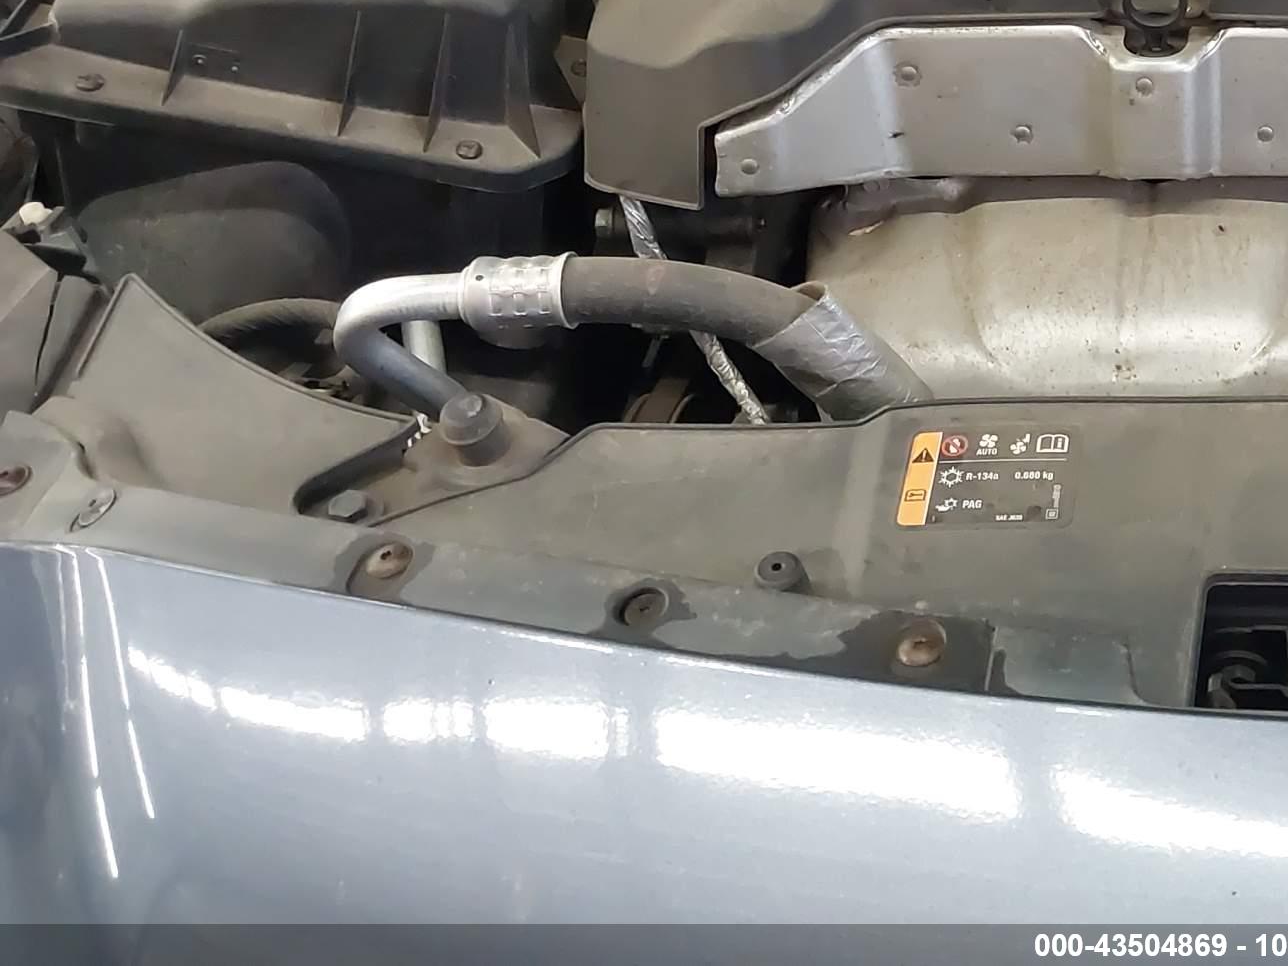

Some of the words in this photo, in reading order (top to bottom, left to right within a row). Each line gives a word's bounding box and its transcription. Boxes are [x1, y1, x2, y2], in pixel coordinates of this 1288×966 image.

[976, 448, 998, 456] AUTO
[965, 472, 999, 481] R-134a
[1042, 471, 1054, 481] kg
[962, 499, 983, 509] PAG
